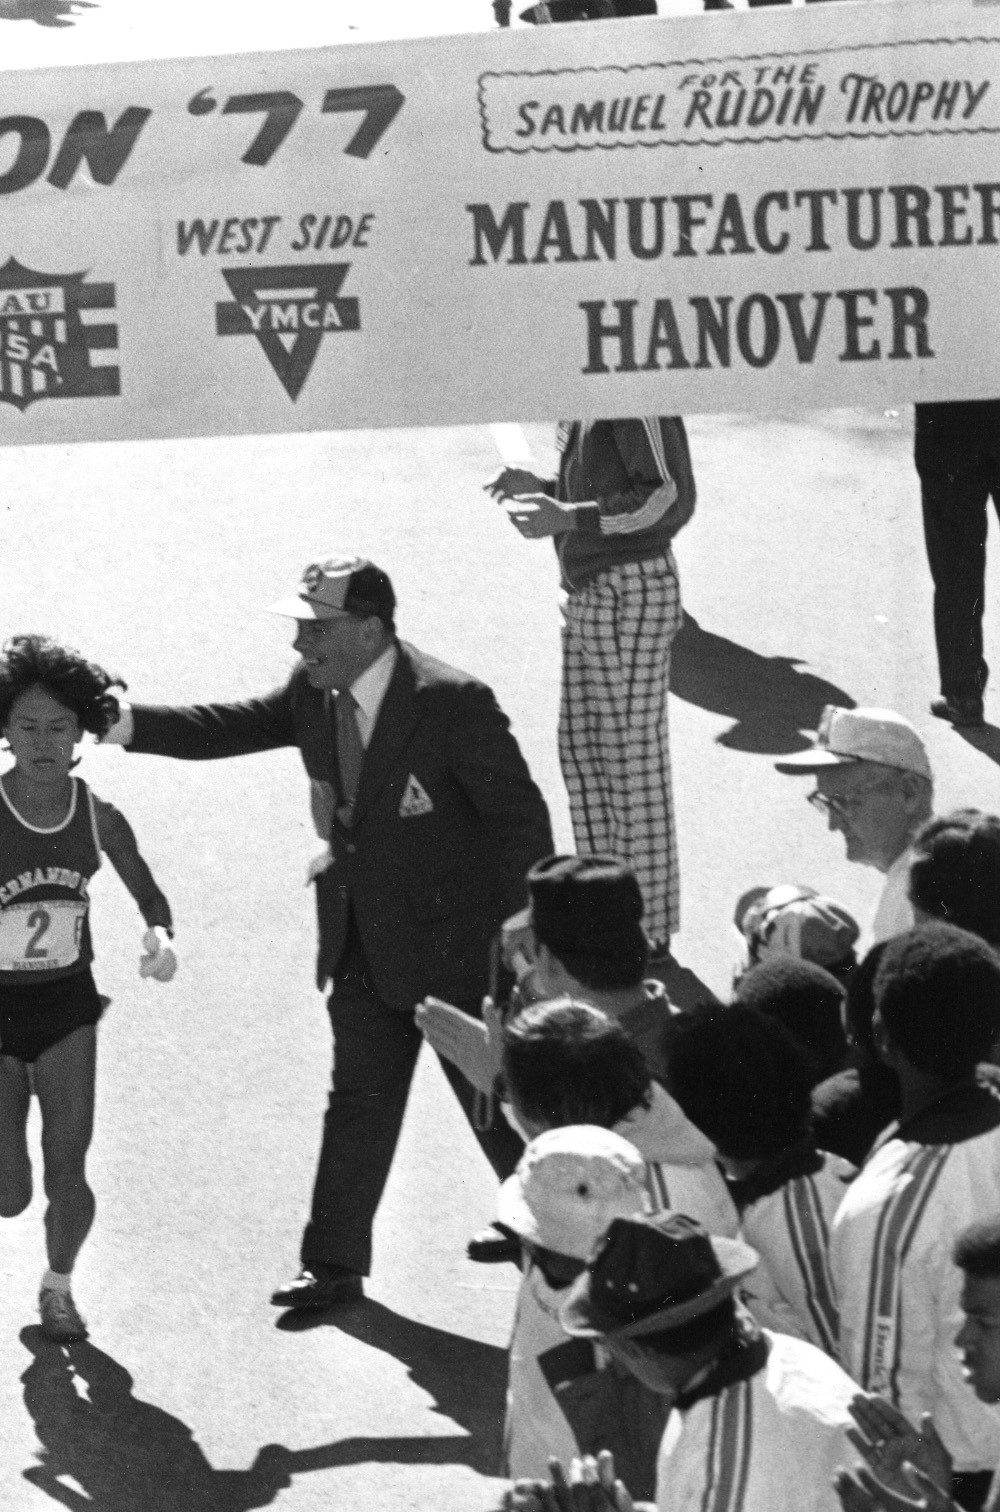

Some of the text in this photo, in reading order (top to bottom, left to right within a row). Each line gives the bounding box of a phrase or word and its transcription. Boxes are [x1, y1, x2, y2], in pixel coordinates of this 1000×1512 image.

[678, 63, 819, 91] FOR THE
[515, 72, 991, 138] SAMUEL RUDIN TROPHY
[175, 212, 377, 258] WEST SIDE
[241, 303, 343, 331] YMCA
[578, 285, 936, 375] HANOVER
[24, 909, 50, 958] 2
